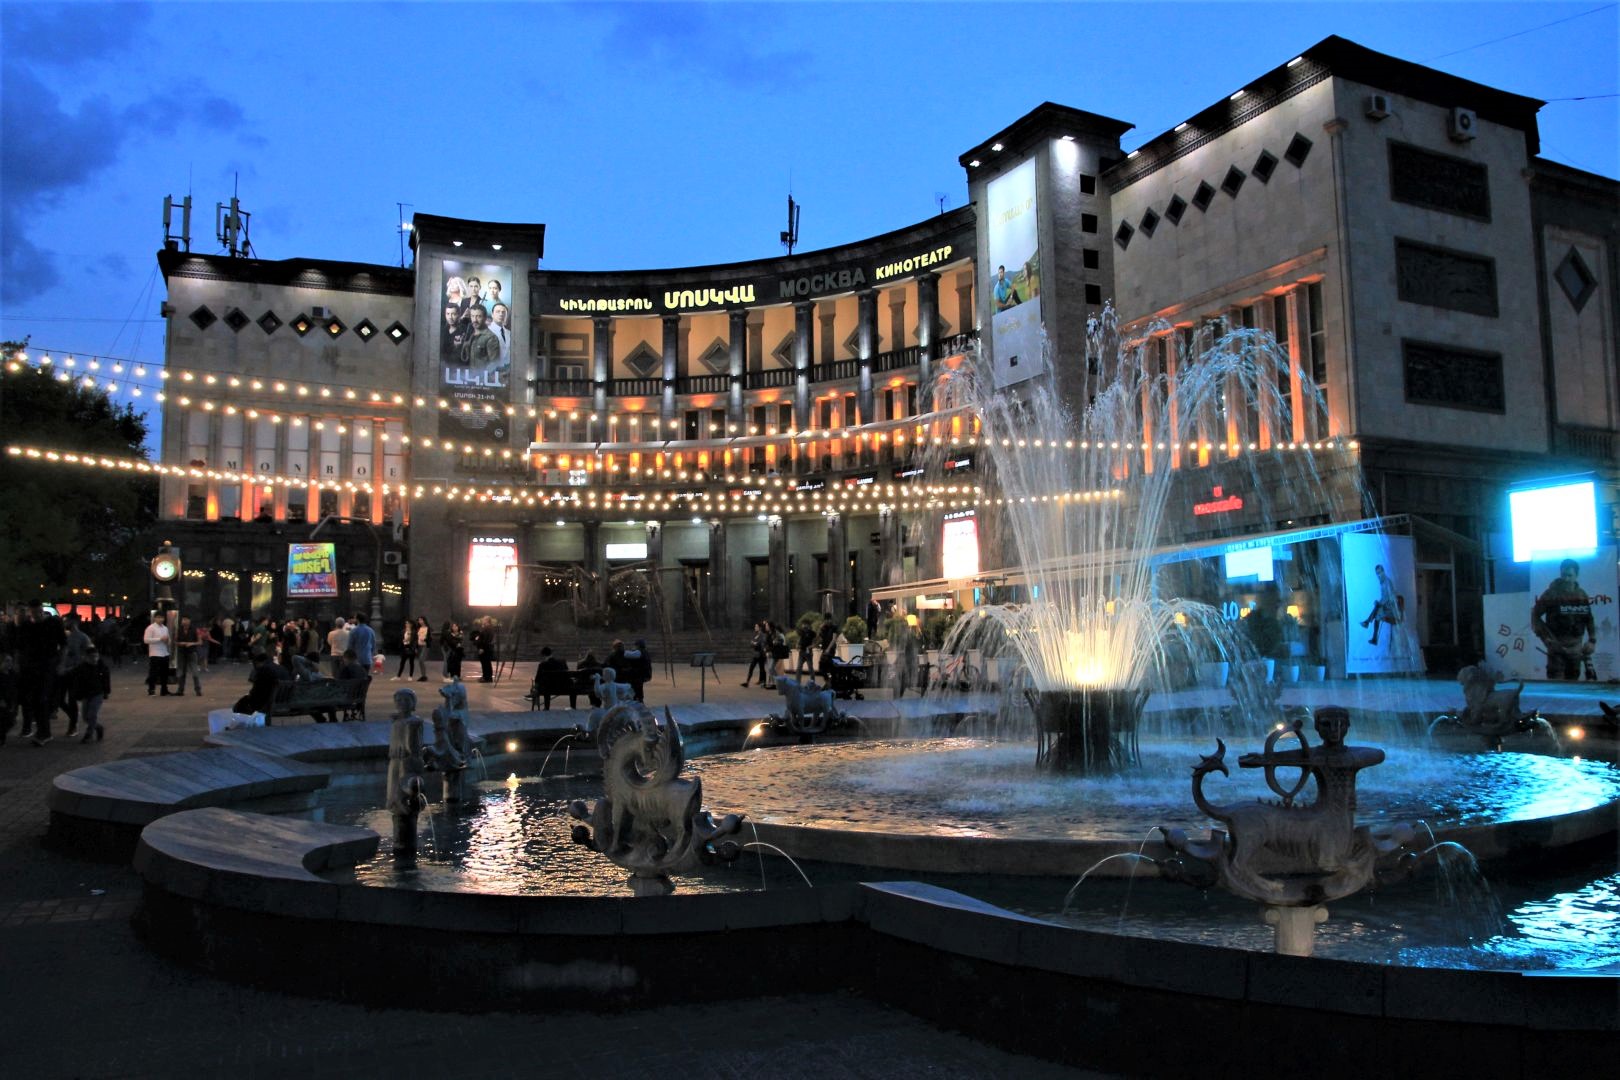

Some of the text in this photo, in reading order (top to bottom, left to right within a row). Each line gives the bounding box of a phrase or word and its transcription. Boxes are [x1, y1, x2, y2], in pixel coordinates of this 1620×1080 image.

[779, 245, 953, 297] МОСКВА КИНОТЕАТР
[559, 284, 755, 311] ԿԻՆՈԹԱՏՐՈՆ ՄՈՍԿՎԱ
[227, 460, 397, 477] MONROE
